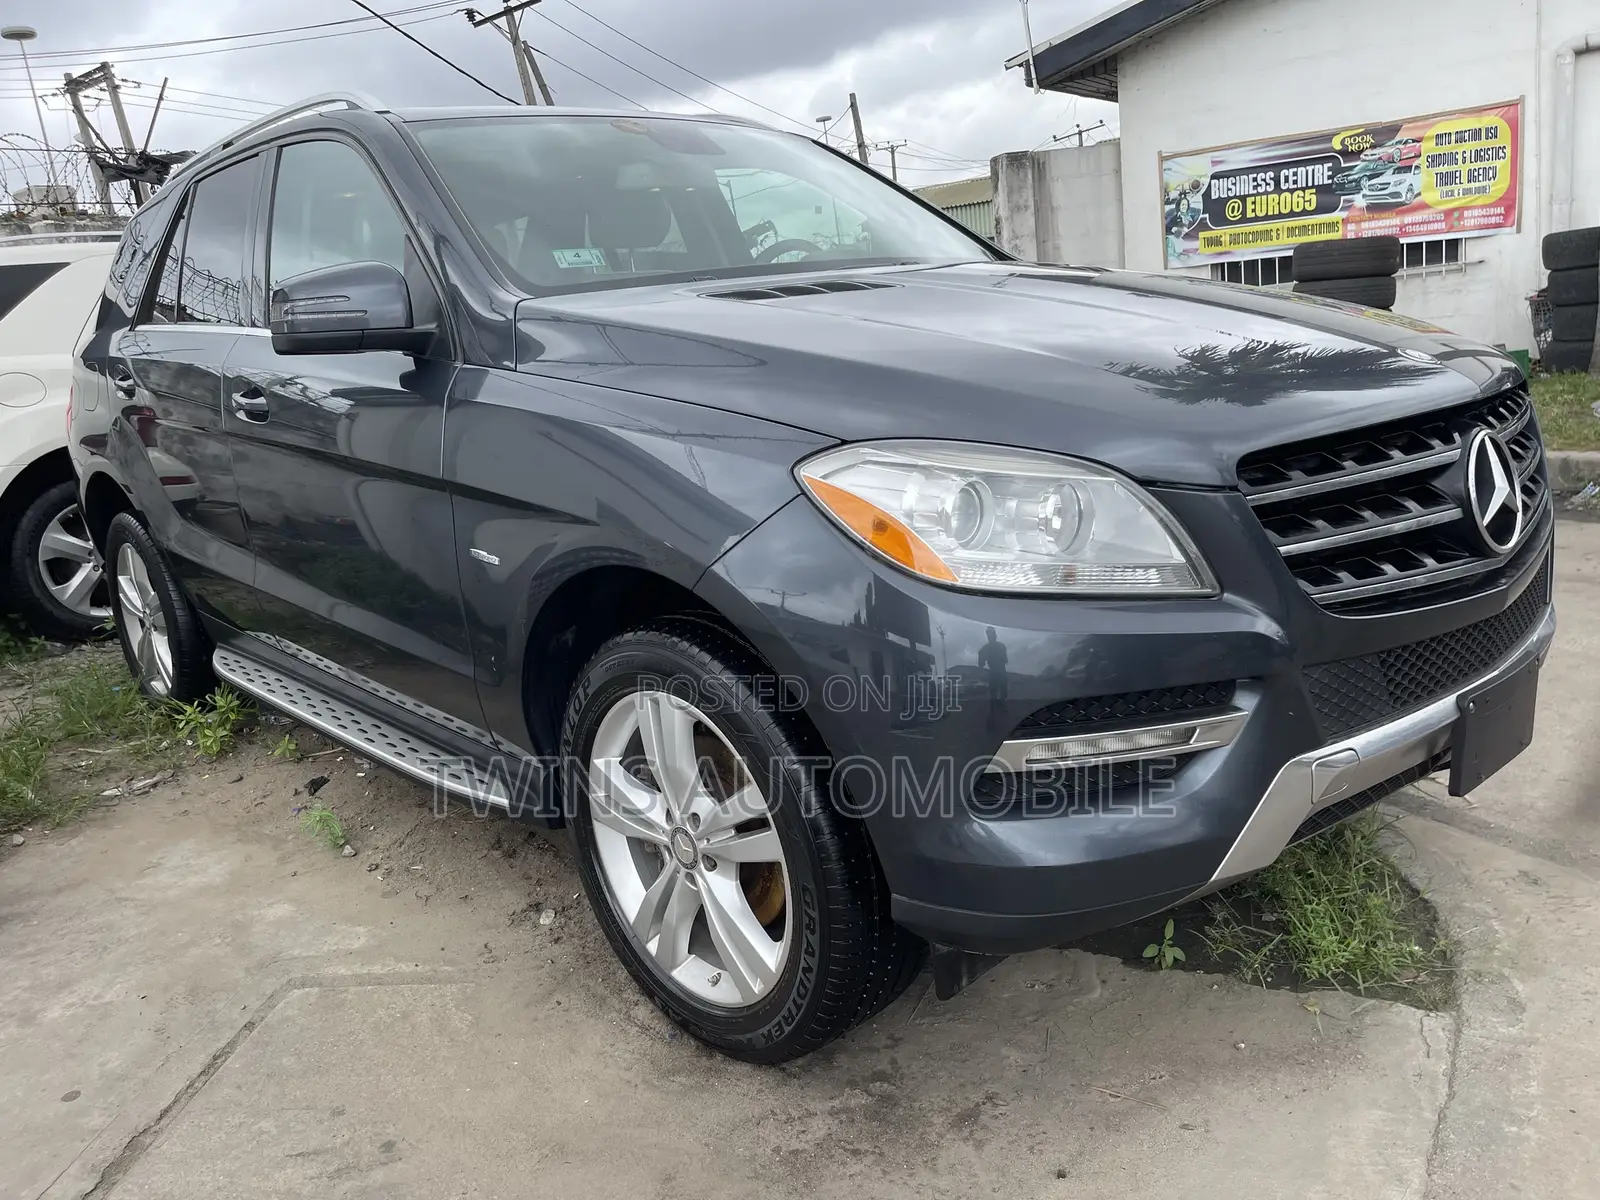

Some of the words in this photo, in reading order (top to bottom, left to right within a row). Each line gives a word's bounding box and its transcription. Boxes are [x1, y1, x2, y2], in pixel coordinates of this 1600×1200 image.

[1344, 134, 1375, 146] BOOK
[1348, 141, 1372, 152] NOW
[1435, 132, 1452, 147] AUTO
[1454, 128, 1482, 144] AUCTION
[1484, 125, 1498, 140] USA
[1426, 151, 1459, 168] SHIPPING
[1461, 150, 1467, 164] &
[1469, 145, 1506, 164] LOGISTICS
[1210, 171, 1275, 199] BUSINESS
[1280, 162, 1333, 190] CENTRE
[1435, 169, 1463, 188] TRAVEL
[1467, 165, 1498, 184] AGENCY
[1225, 198, 1243, 220] @
[1246, 188, 1317, 218] EURO65
[1203, 235, 1223, 249] TYPING
[1229, 229, 1274, 246] PHOTOCOPYING
[1286, 221, 1340, 238] DOCUMENTATIONS
[760, 883, 818, 1046] GRANDTREK
